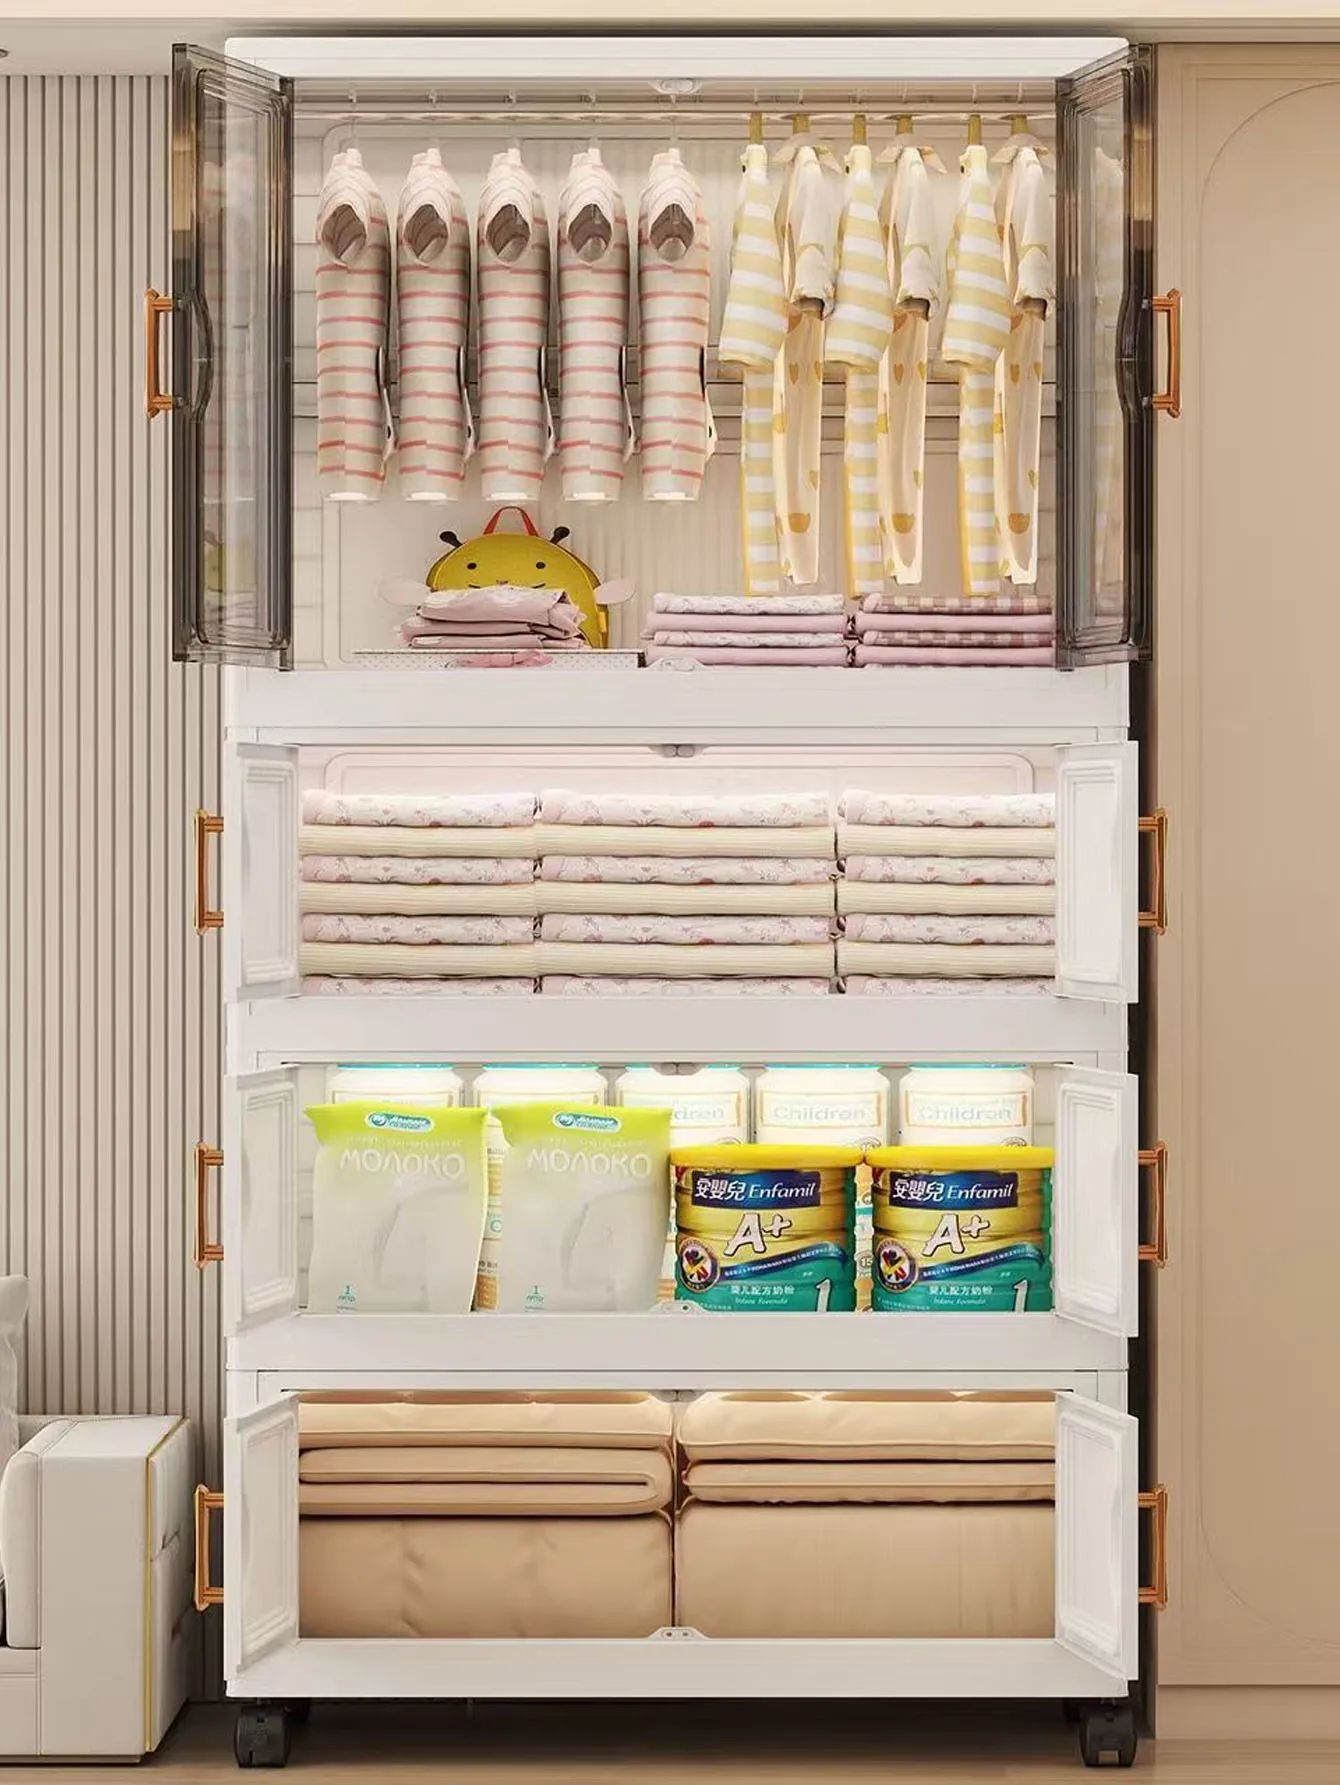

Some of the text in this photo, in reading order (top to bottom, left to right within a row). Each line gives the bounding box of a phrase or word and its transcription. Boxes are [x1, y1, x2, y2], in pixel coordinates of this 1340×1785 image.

[671, 1105, 725, 1121] dren
[773, 1105, 865, 1121] Children
[918, 1105, 1012, 1121] Children
[340, 1149, 466, 1179] МОЛОКО
[526, 1149, 652, 1179] МОЛОКО
[749, 1181, 816, 1199] Enfamil
[947, 1182, 1014, 1200] Enfamil
[723, 1212, 793, 1257] A+
[921, 1212, 991, 1257] A+
[815, 1277, 832, 1312] 1
[1013, 1278, 1030, 1312] 1
